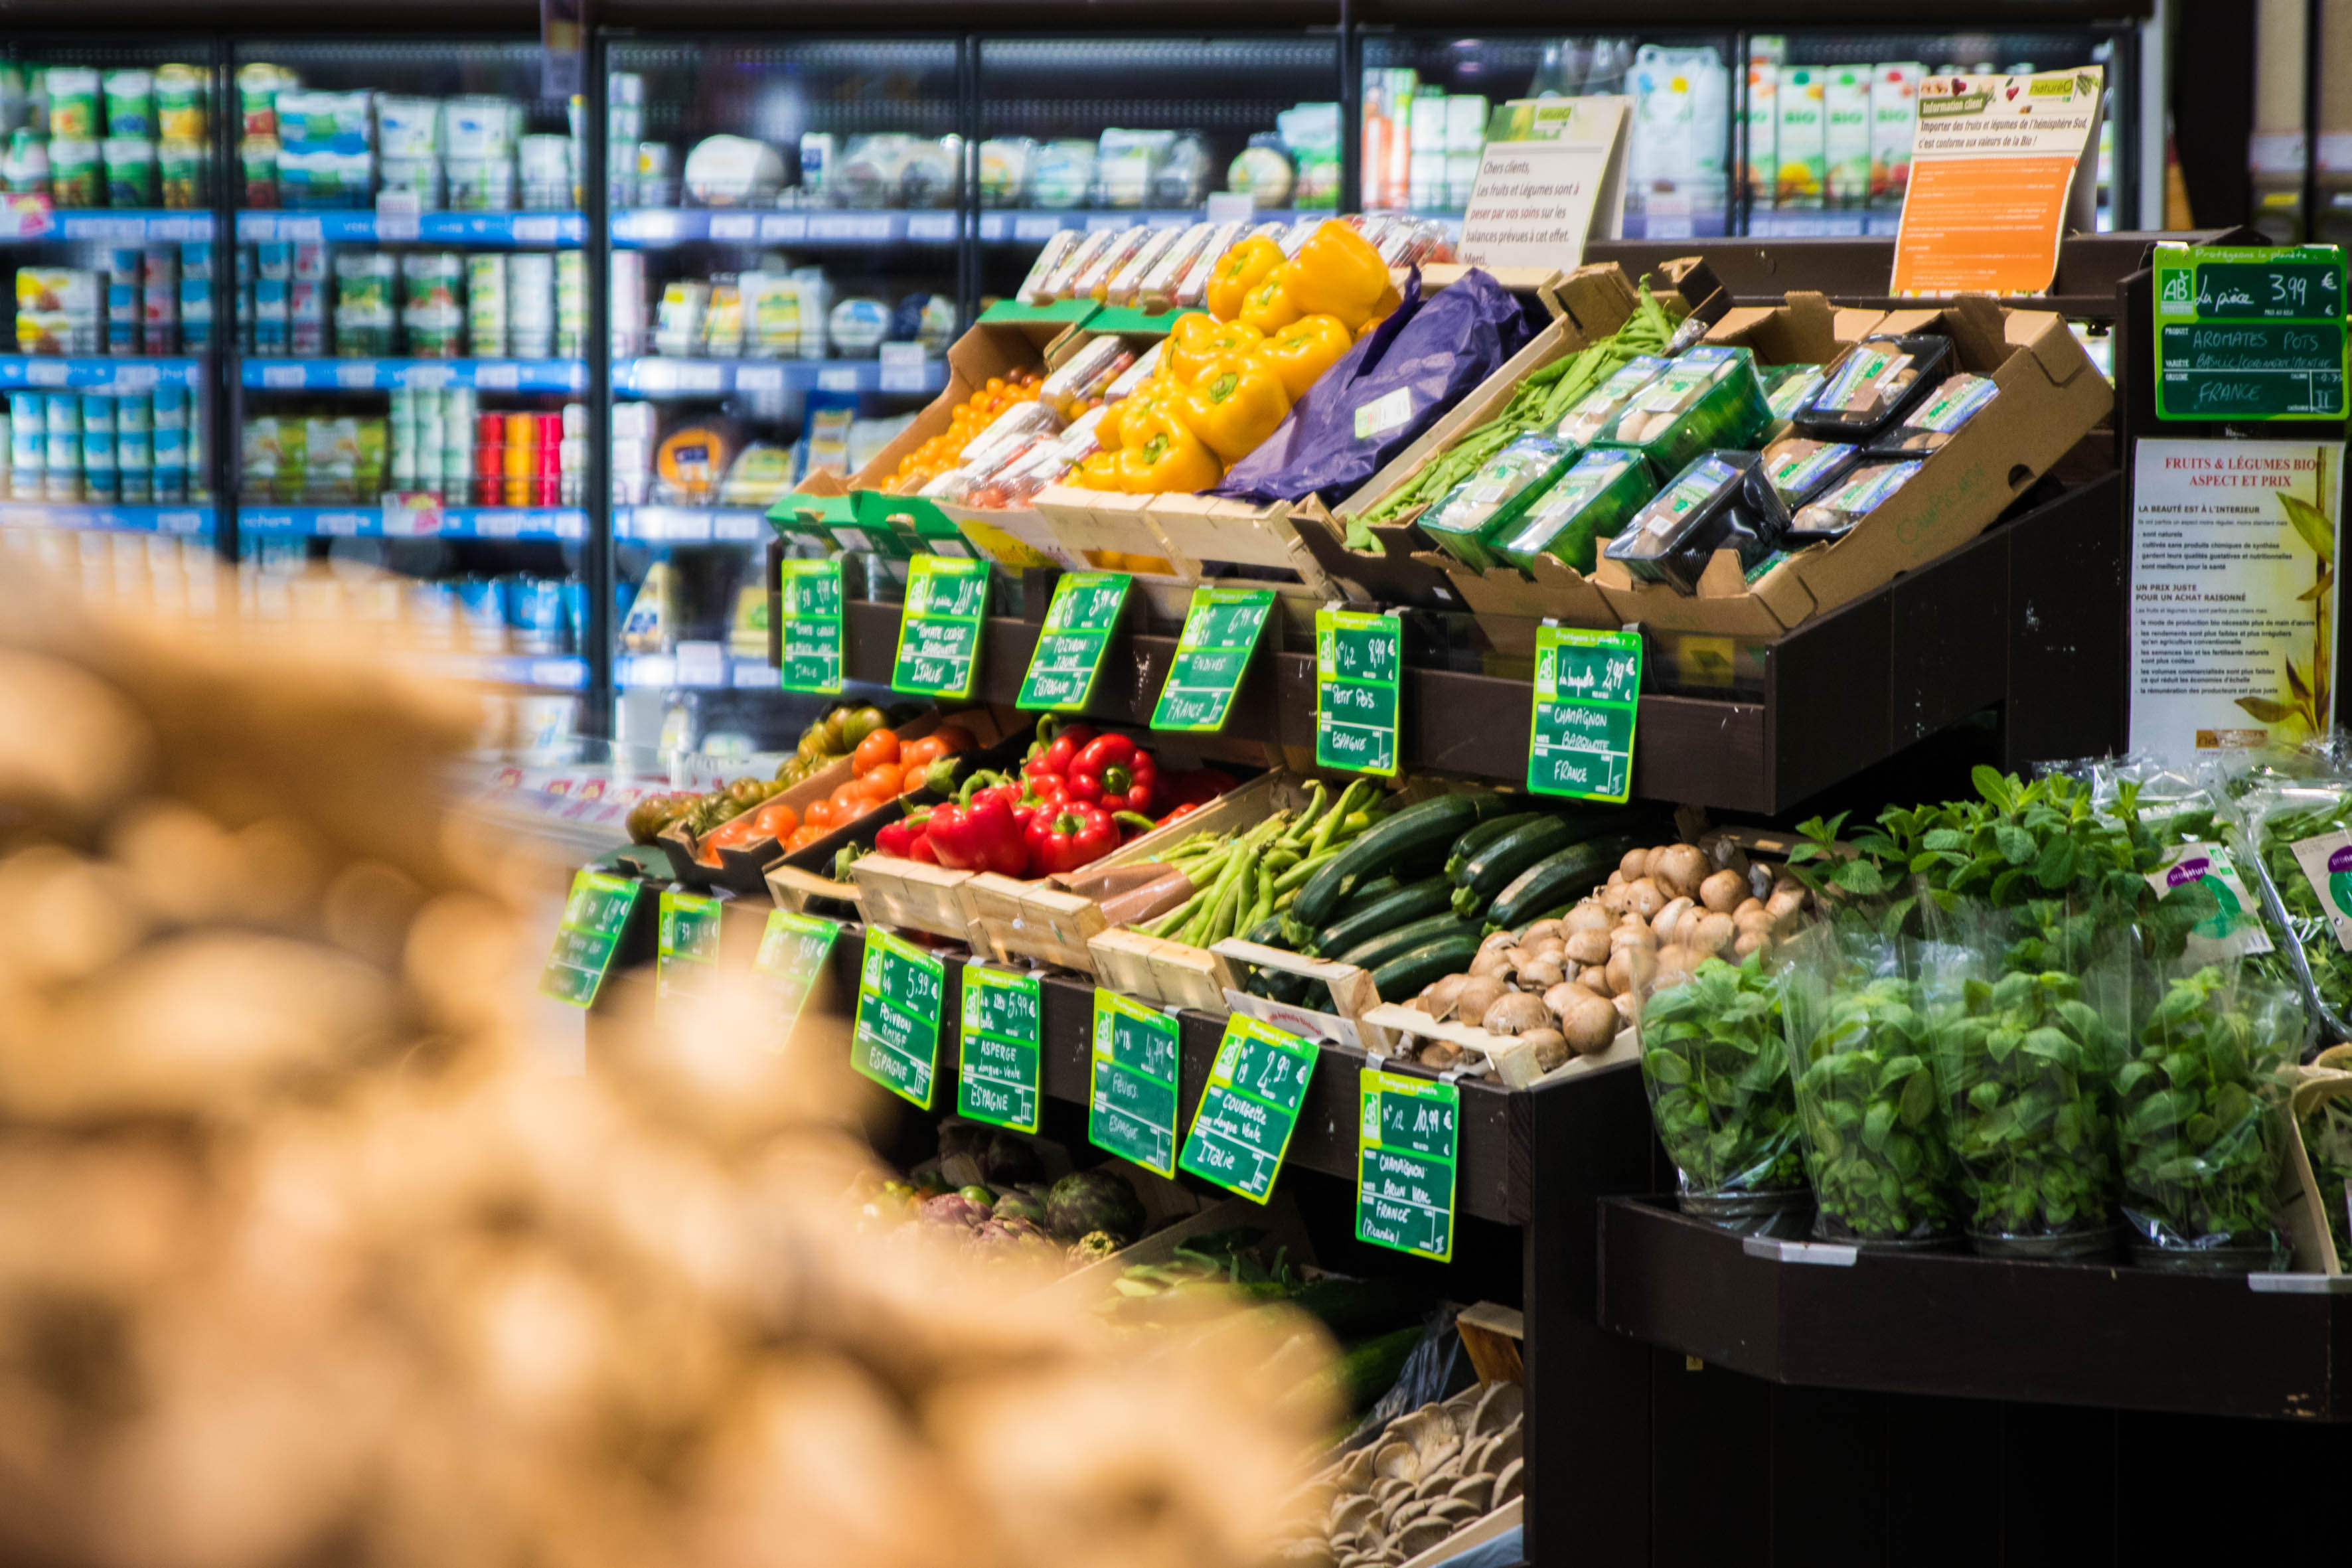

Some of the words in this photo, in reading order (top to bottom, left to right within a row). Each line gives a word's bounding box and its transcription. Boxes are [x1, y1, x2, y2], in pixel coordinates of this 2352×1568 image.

[1923, 101, 1963, 113] Information
[1965, 98, 1982, 109] client
[1921, 121, 1950, 133] Importer
[1953, 121, 1963, 131] des
[1965, 119, 1982, 131] fruits
[1984, 121, 1989, 130] et
[1992, 119, 2017, 133] légumes
[2020, 120, 2028, 129] de
[2030, 119, 2071, 130] l'hémisphère
[2073, 118, 2086, 129] Sud,
[1919, 139, 1934, 149] c'est
[1936, 137, 1964, 147] conforme
[1966, 137, 1976, 146] aux
[1978, 137, 2001, 146] valeurs
[2003, 136, 2011, 145] de
[2013, 136, 2019, 145] la
[2021, 136, 2032, 146] Bio
[2034, 136, 2037, 145] !
[1484, 162, 1503, 174] Chers
[1505, 162, 1529, 175] clients,
[1477, 185, 1488, 196] Les
[1490, 184, 1509, 196] fruits
[1510, 185, 1518, 196] et
[1520, 185, 1553, 200] Légumes
[1555, 186, 1571, 195] sont
[1574, 185, 1579, 195] à
[1470, 208, 1490, 222] peser
[1492, 209, 1504, 220] par
[1506, 208, 1518, 218] vos
[1520, 206, 1539, 218] soins
[1541, 208, 1553, 218] sur
[1555, 207, 1565, 218] les
[1466, 229, 1497, 242] balances
[1498, 230, 1528, 244] prévues
[1529, 230, 1534, 242] à
[1536, 230, 1547, 241] cet
[1550, 228, 1569, 242] effet.
[1464, 254, 1487, 266] Merci.
[2195, 250, 2254, 263] Protégeons
[2270, 249, 2307, 262] planète
[2269, 274, 2307, 306] 3,99
[2321, 272, 2337, 289] €
[2193, 331, 2268, 349] AROMATES
[2284, 331, 2318, 350] POTS
[2199, 382, 2262, 402] FRANCE
[2165, 457, 2211, 469] FRUITS
[2215, 458, 2223, 469] &
[2229, 455, 2290, 470] LÉGUMES
[2294, 459, 2316, 470] BIO
[2189, 475, 2238, 487] ASPECT
[2242, 476, 2257, 487] ET
[2261, 476, 2291, 487] PRIX
[2152, 505, 2181, 513] BEAUTÉ
[2201, 505, 2207, 513] À
[1110, 591, 1120, 607] €
[1228, 609, 1251, 633] 6,99
[1253, 609, 1263, 625] €
[1344, 646, 1356, 669] 42
[1369, 639, 1385, 668] 8,99
[1387, 639, 1395, 657] €
[1603, 658, 1624, 690] 2,99
[1626, 657, 1635, 676] €
[1166, 698, 1204, 721] FRANCE
[1332, 731, 1366, 751] ESPAGNE
[1554, 760, 1587, 782] FRANCE
[883, 977, 891, 996] 44
[931, 982, 938, 999] €
[1029, 1001, 1035, 1018] €
[882, 1026, 906, 1048] ROUGE
[1123, 1030, 1131, 1050] 18
[1167, 1041, 1174, 1059] €
[981, 1041, 1016, 1061] ASPERGE
[869, 1046, 907, 1081] ESPAGNE
[1237, 1063, 1249, 1083] 19
[1296, 1064, 1306, 1085] €
[971, 1085, 1008, 1111] ESPAGNE
[1109, 1115, 1138, 1139] ESPAGNE
[1413, 1103, 1439, 1138] 10,99
[1443, 1110, 1452, 1130] €
[1376, 1200, 1411, 1223] FRANCE
